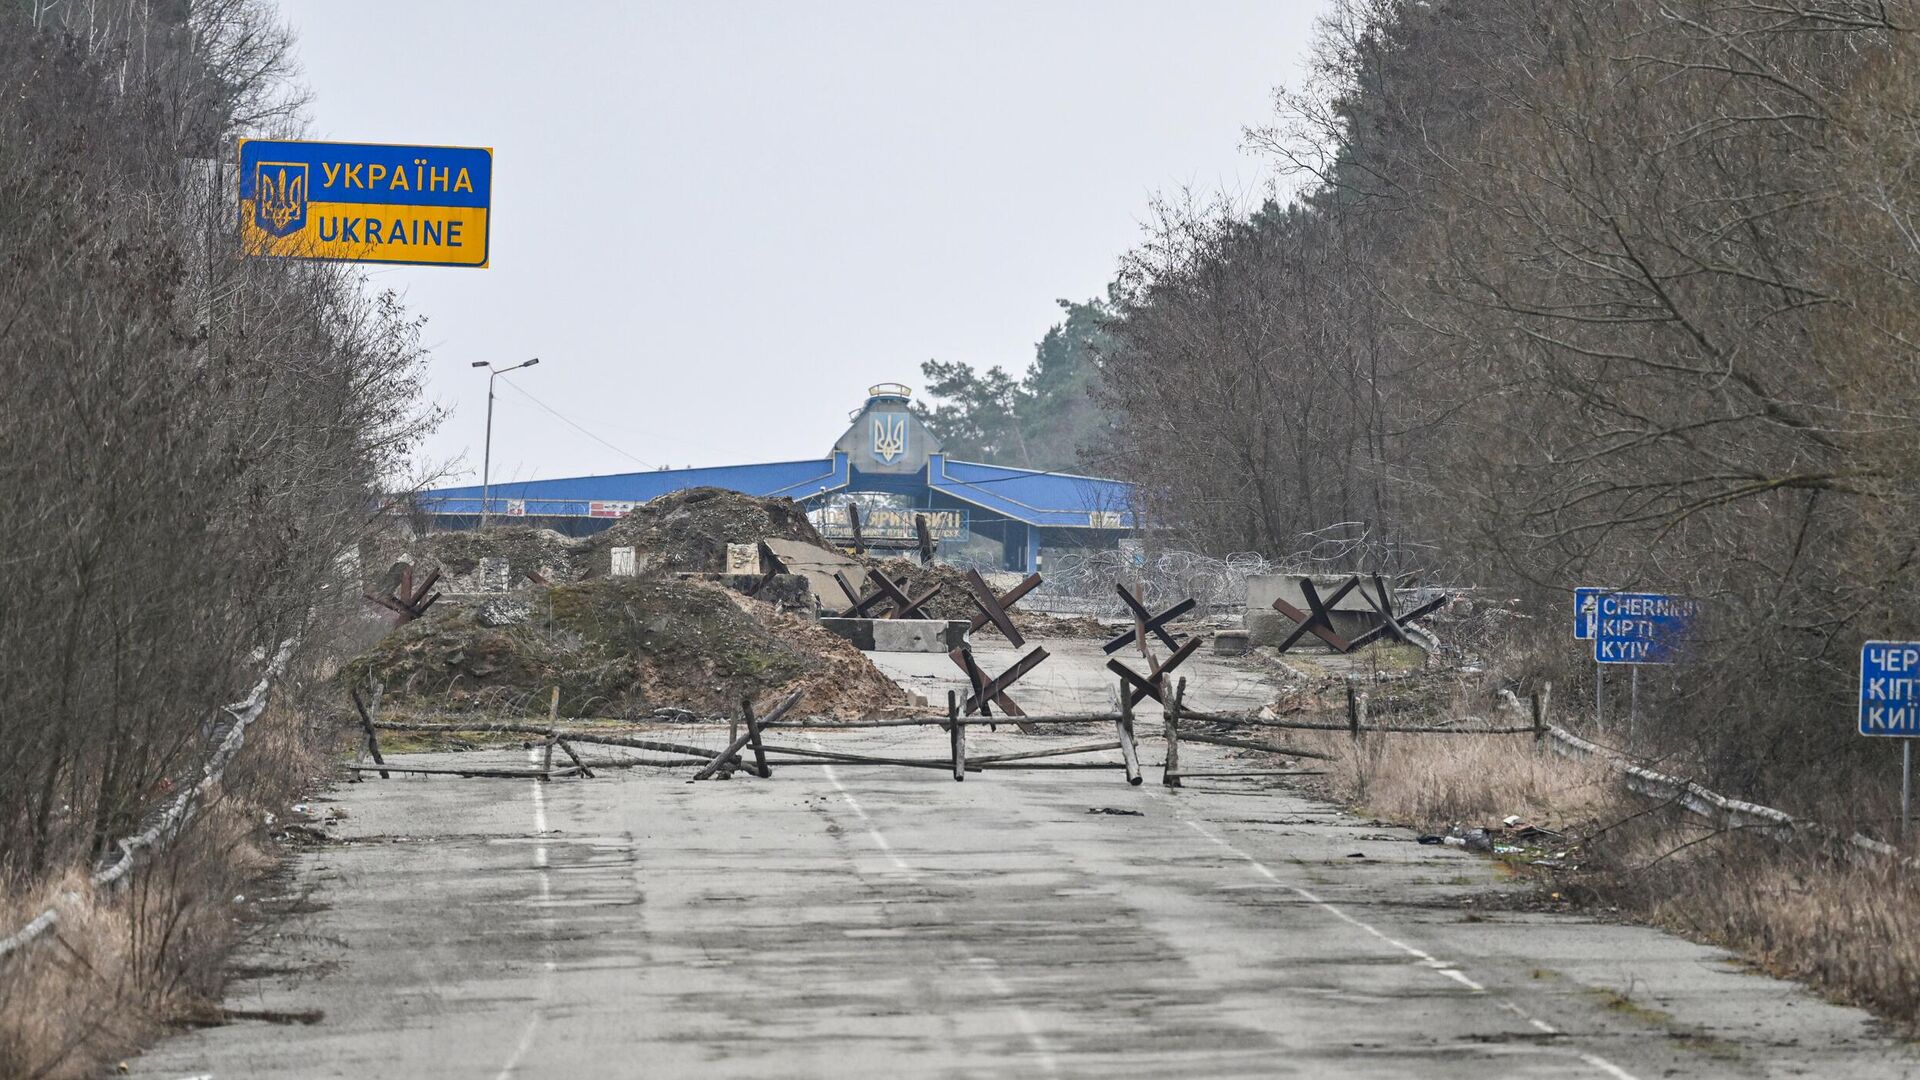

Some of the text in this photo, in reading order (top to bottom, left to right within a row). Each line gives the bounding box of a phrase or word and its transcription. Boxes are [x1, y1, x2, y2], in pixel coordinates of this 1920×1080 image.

[322, 158, 474, 193] УКРАЇНА
[318, 216, 464, 247] UKRAINE
[1602, 619, 1653, 637] KIPTI
[1601, 641, 1649, 658] KYIV
[1870, 649, 1919, 671] ЧЕР
[1868, 702, 1920, 729] КИЇ
